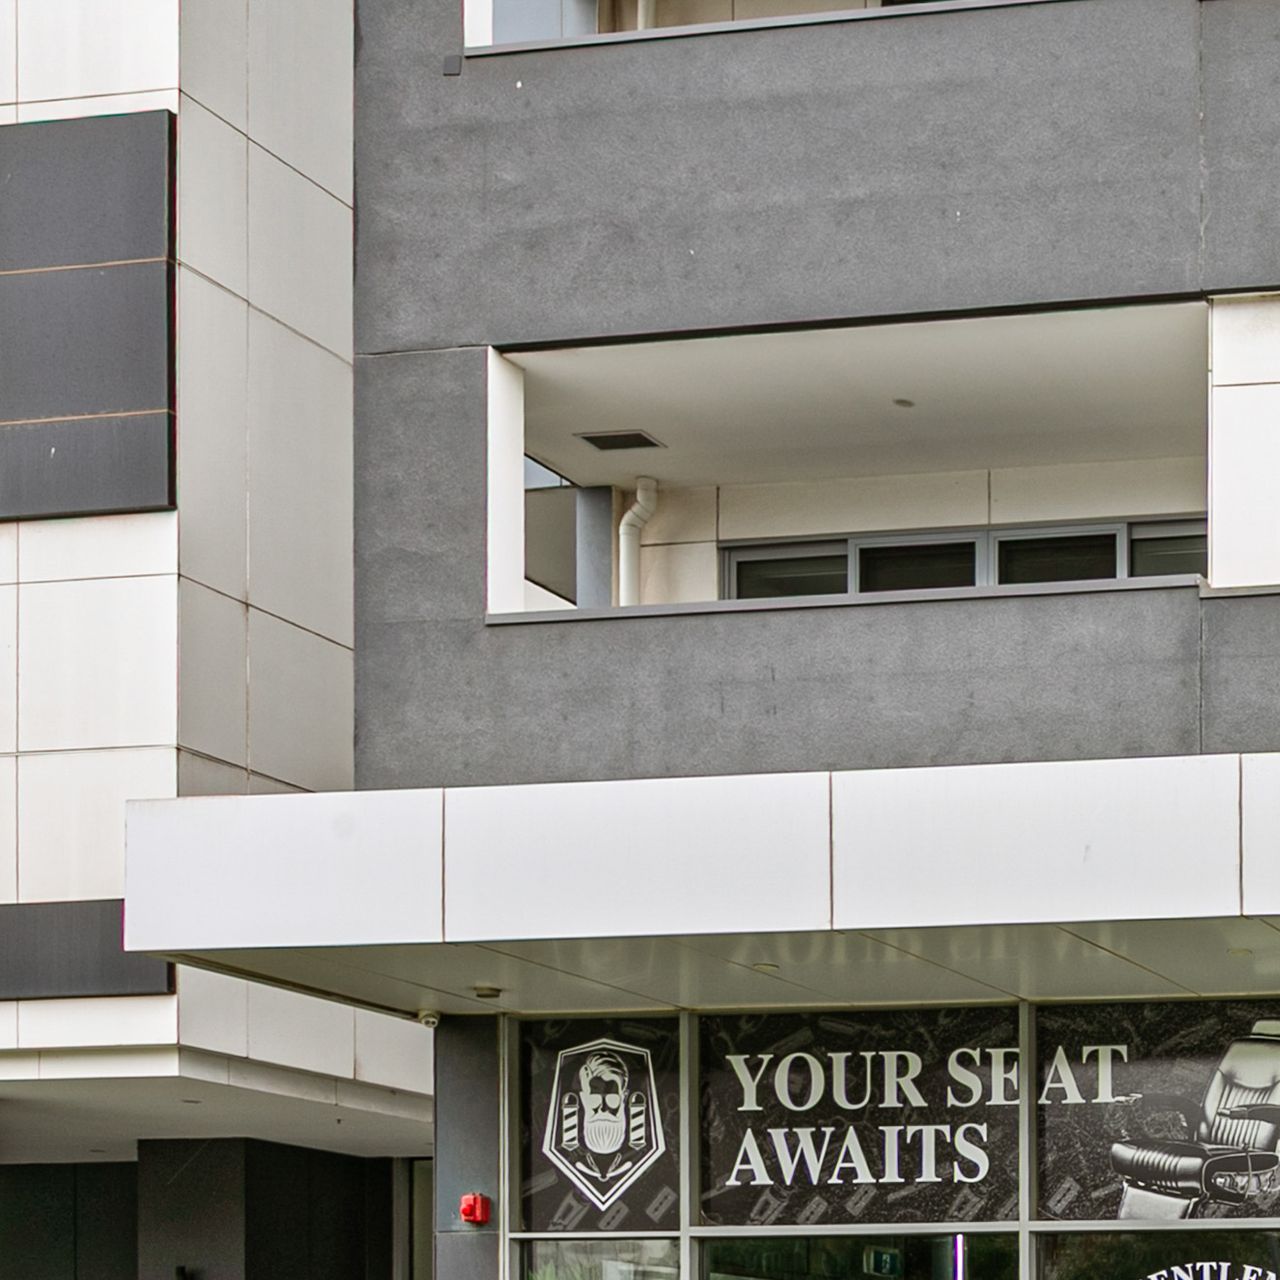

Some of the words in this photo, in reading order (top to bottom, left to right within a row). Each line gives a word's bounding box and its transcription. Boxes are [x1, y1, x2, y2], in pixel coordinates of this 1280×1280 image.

[725, 1050, 928, 1112] YOUR
[946, 1044, 1128, 1107] SEAT
[725, 1121, 990, 1187] AWAITS
